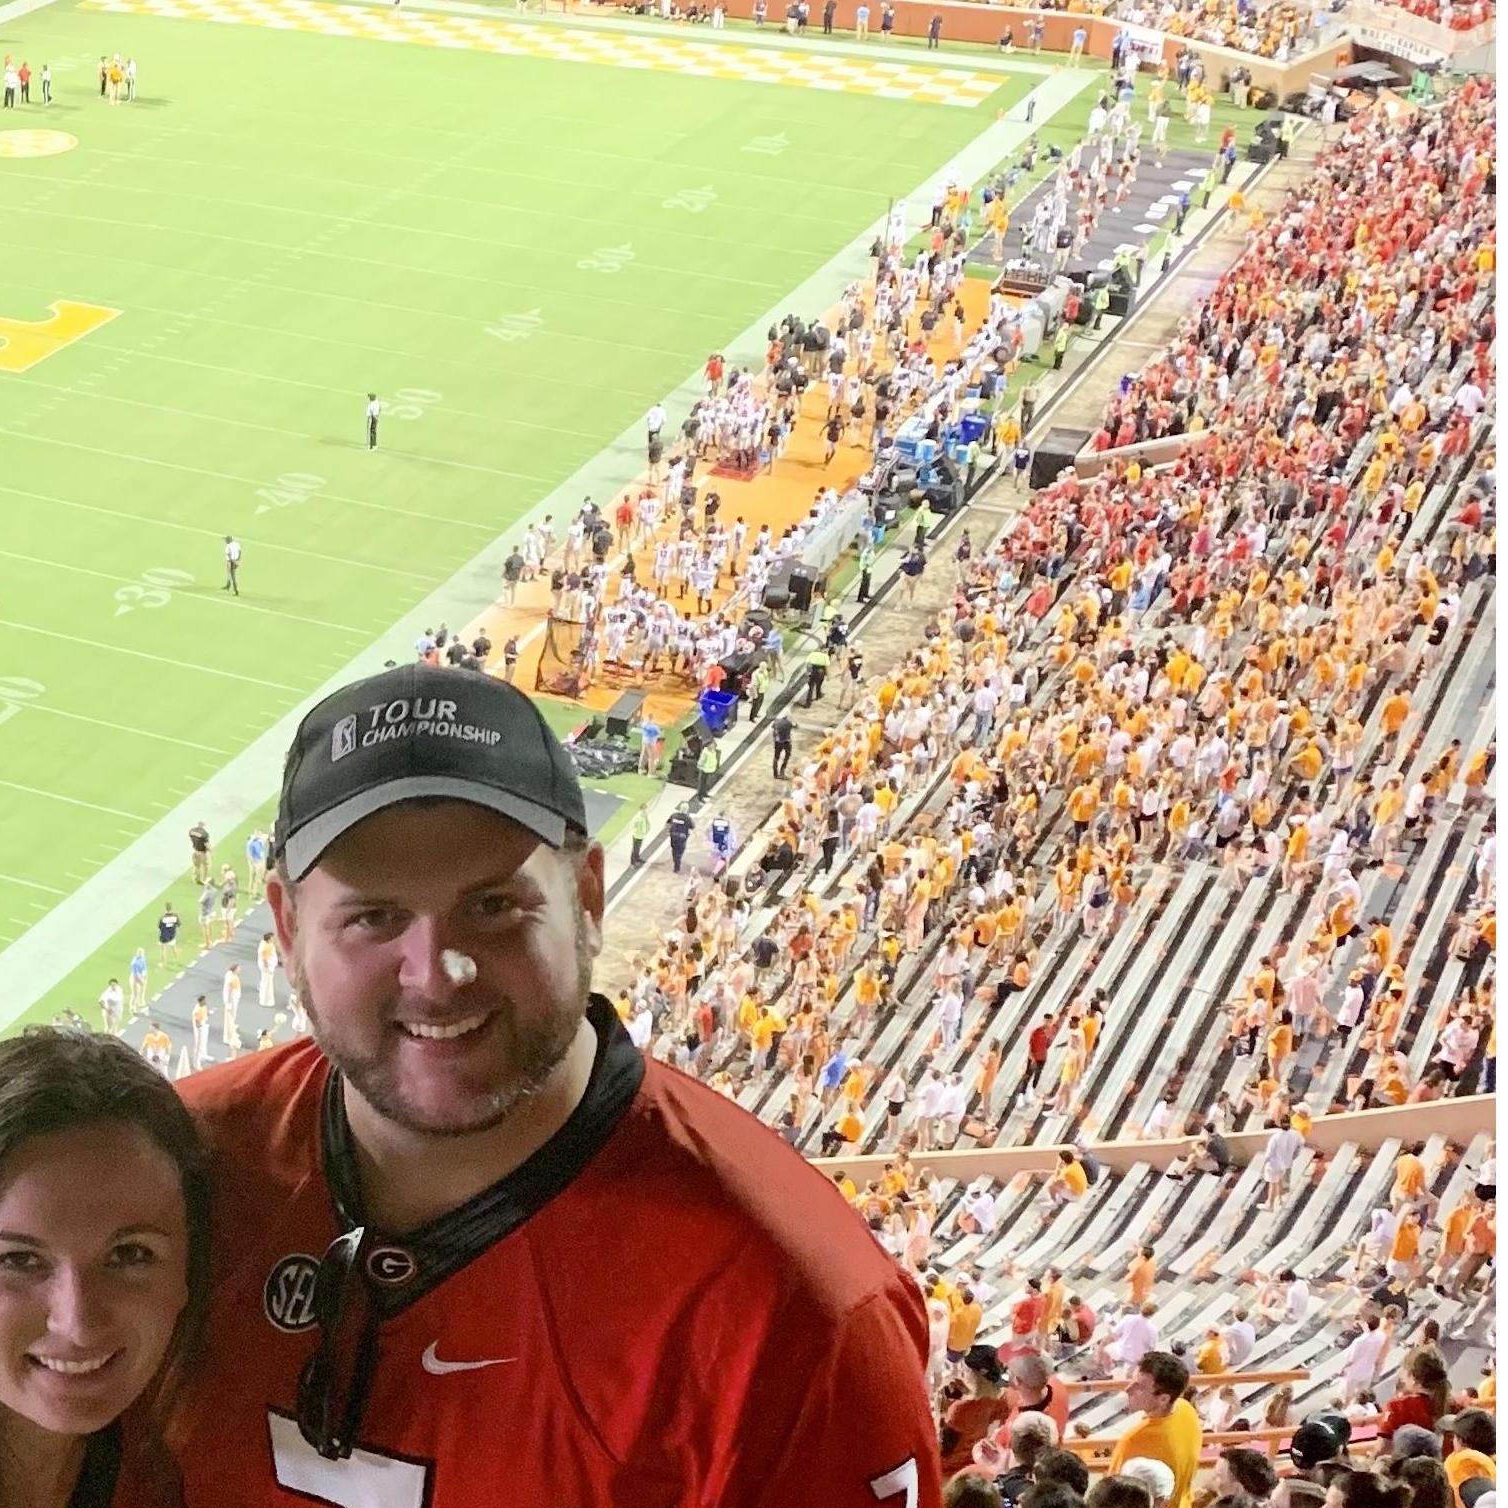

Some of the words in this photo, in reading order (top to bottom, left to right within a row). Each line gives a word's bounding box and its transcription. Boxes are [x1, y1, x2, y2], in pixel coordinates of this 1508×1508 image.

[255, 472, 328, 508] 40
[114, 567, 196, 609] 30
[369, 697, 458, 728] TOUR
[361, 720, 501, 747] CHAMPIONSHIP
